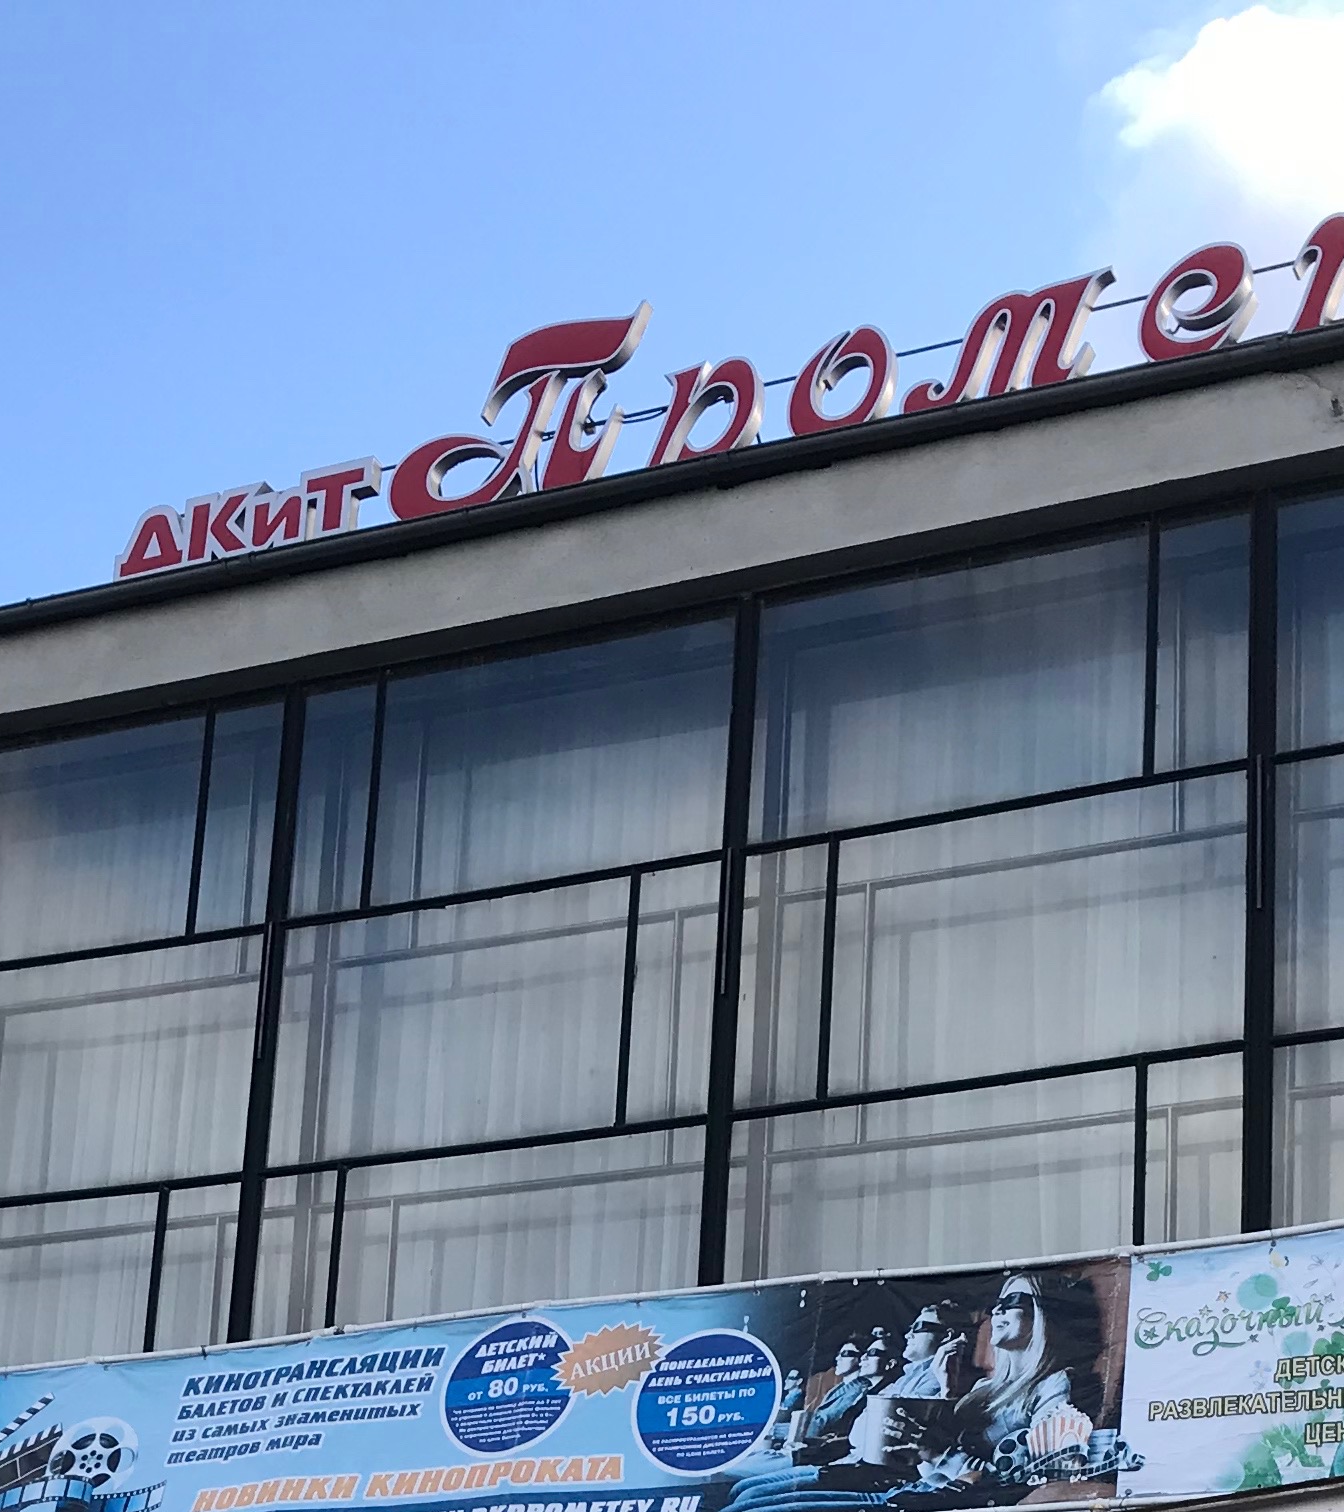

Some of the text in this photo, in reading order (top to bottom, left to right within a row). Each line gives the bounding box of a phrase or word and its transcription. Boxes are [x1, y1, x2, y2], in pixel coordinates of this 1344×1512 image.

[1134, 1293, 1324, 1357] Сказочный
[475, 1332, 558, 1358] ДЕТСКИЙ
[570, 1341, 651, 1380] АКЦИИ
[182, 1347, 445, 1397] КИНОТРАНСЛЯЦИИ
[648, 1365, 773, 1388] ДЕНЬ СЧАСТЛИВЫЙ
[659, 1354, 754, 1371] ПОНЕДЕЛЬНИК
[177, 1373, 434, 1420] БАЛЕТОВ И СПЕКТАКЛЕЙ
[488, 1377, 518, 1398] 80
[657, 1387, 755, 1405] ВСЕ БИЛЕТЫ ПО
[171, 1403, 422, 1442] из самых знаменитых
[667, 1405, 716, 1427] 150
[167, 1433, 323, 1465] театров мира
[193, 1456, 623, 1512] НОВИНКИ КИНОПРОКАТА
